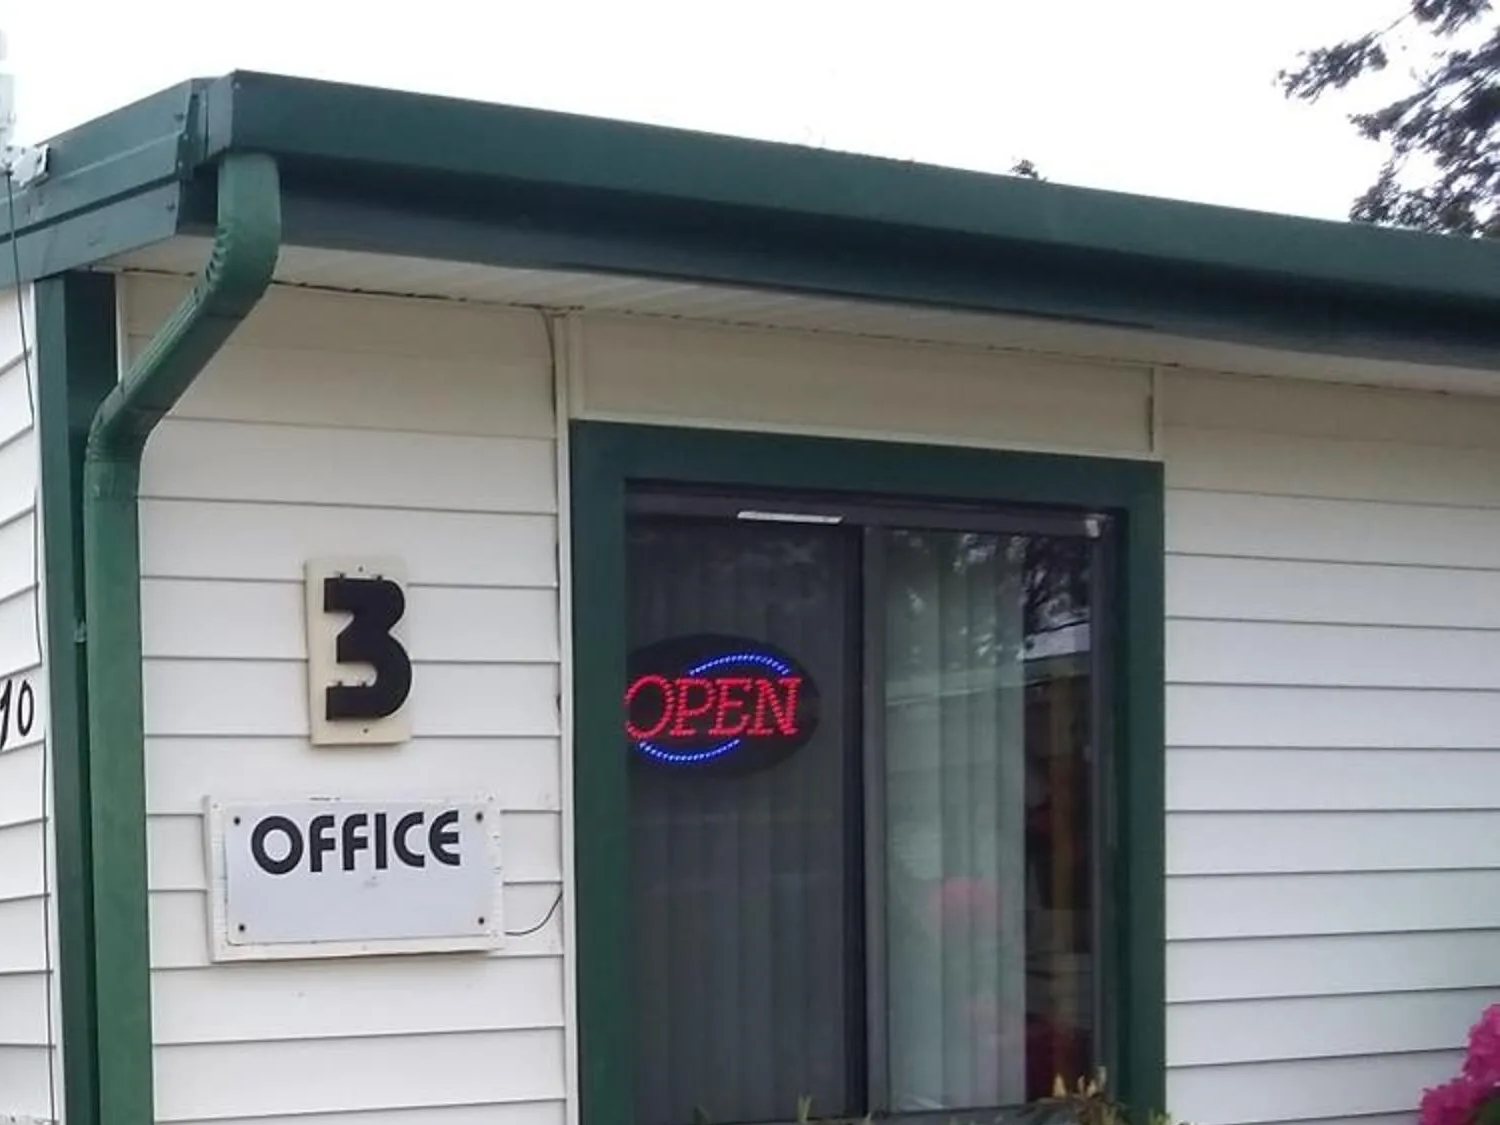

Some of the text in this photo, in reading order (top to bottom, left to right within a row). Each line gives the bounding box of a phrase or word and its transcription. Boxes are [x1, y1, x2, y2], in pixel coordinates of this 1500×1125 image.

[323, 576, 412, 721] 3
[624, 674, 802, 740] OPEN
[251, 809, 461, 875] OFFICE
